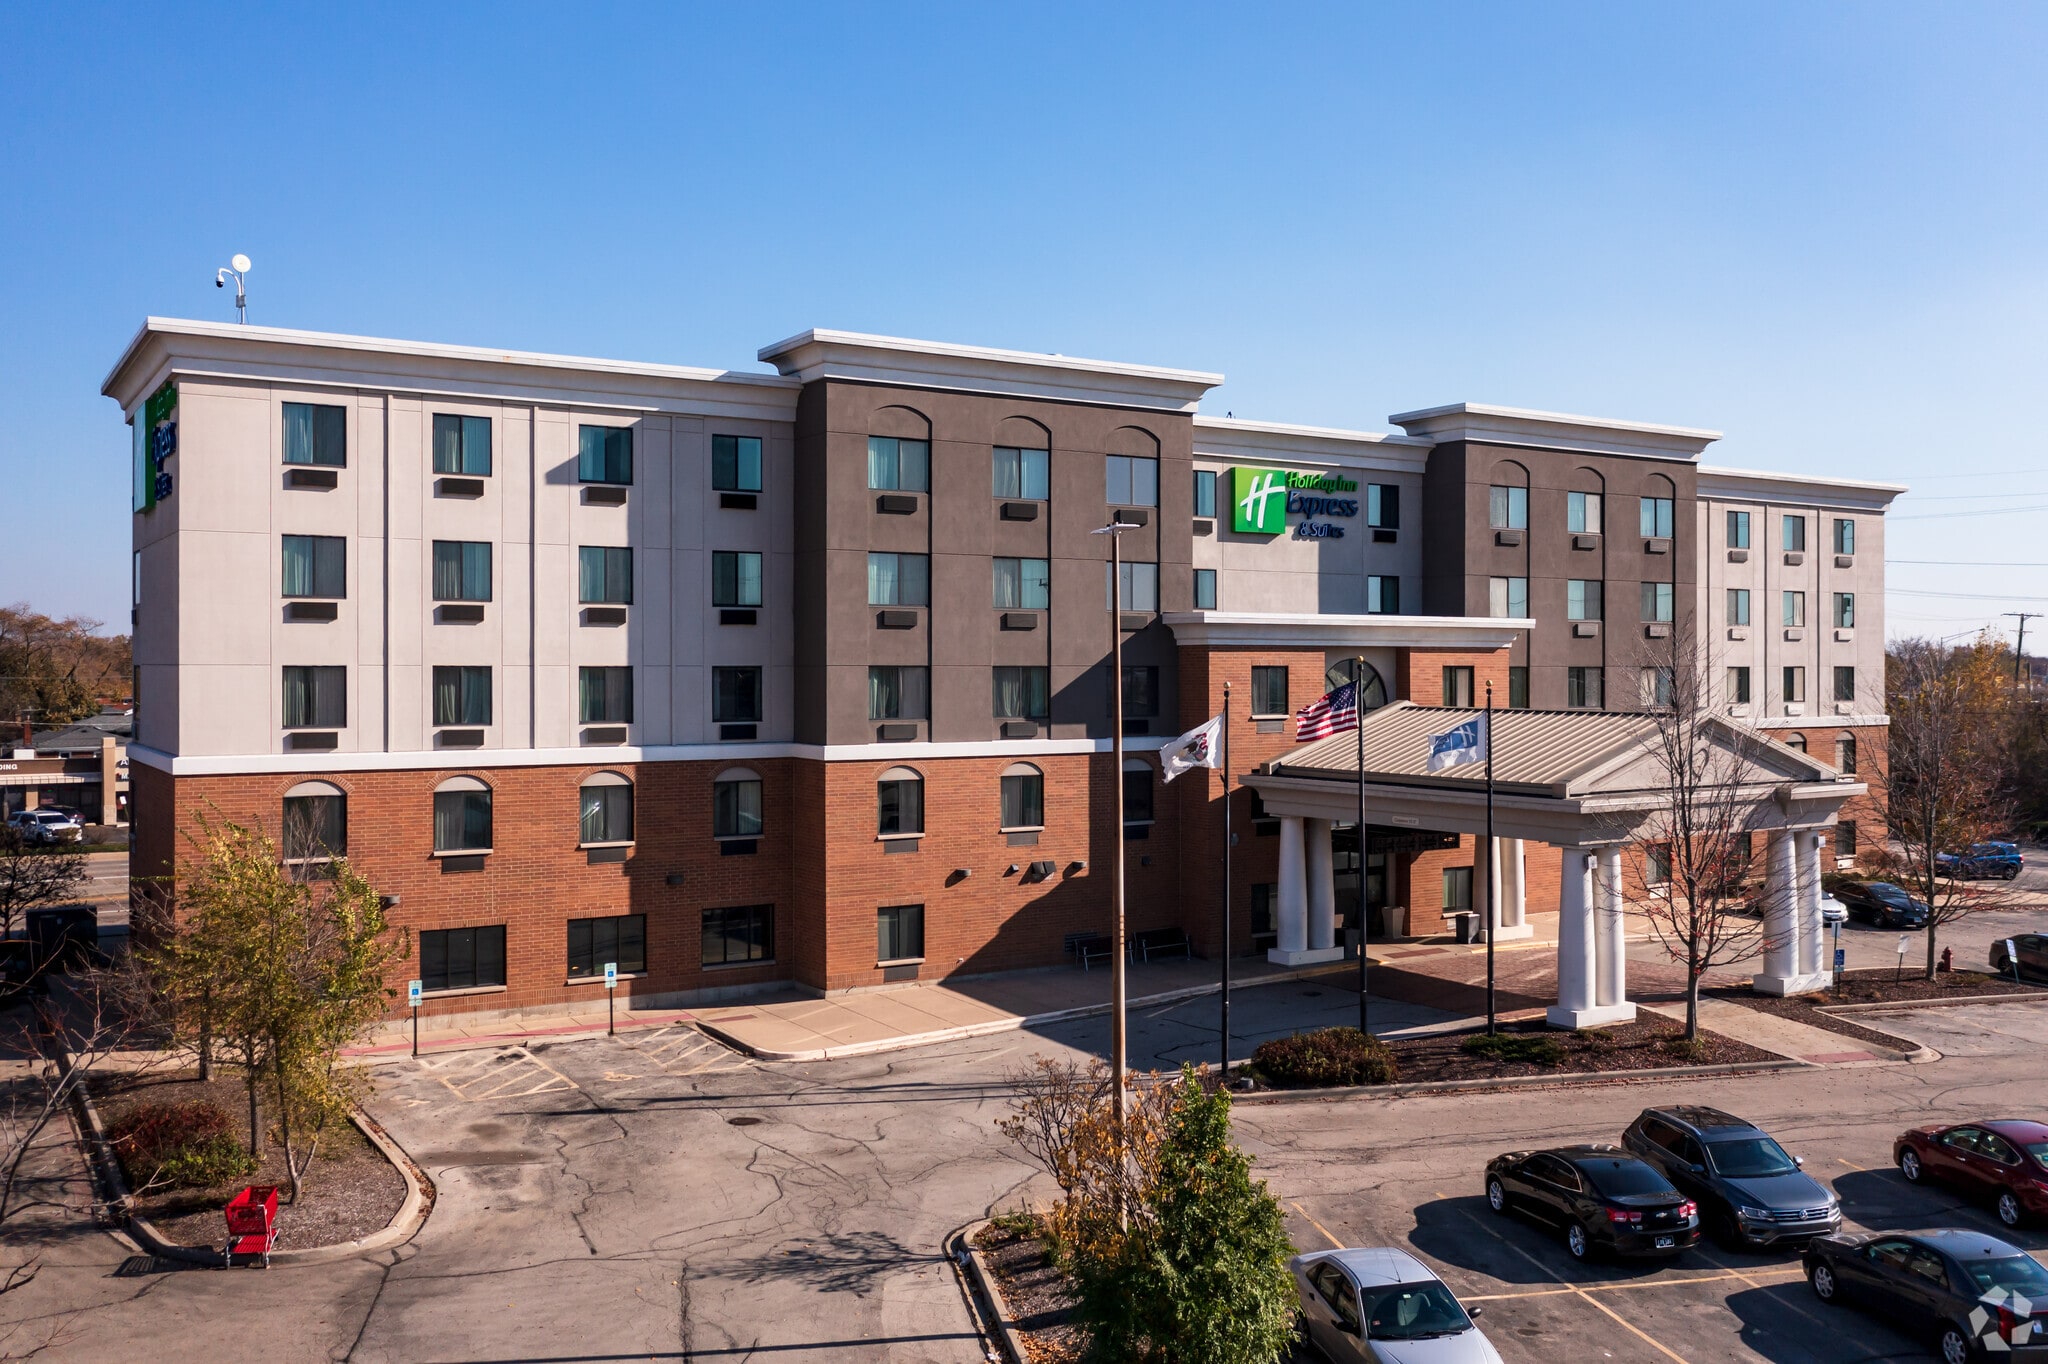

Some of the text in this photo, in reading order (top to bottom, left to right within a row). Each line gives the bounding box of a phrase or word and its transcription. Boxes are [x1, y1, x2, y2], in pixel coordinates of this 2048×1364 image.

[1287, 471, 1358, 494] Holiday Inn
[1286, 490, 1358, 520] Express
[1299, 521, 1345, 538] & Suites
